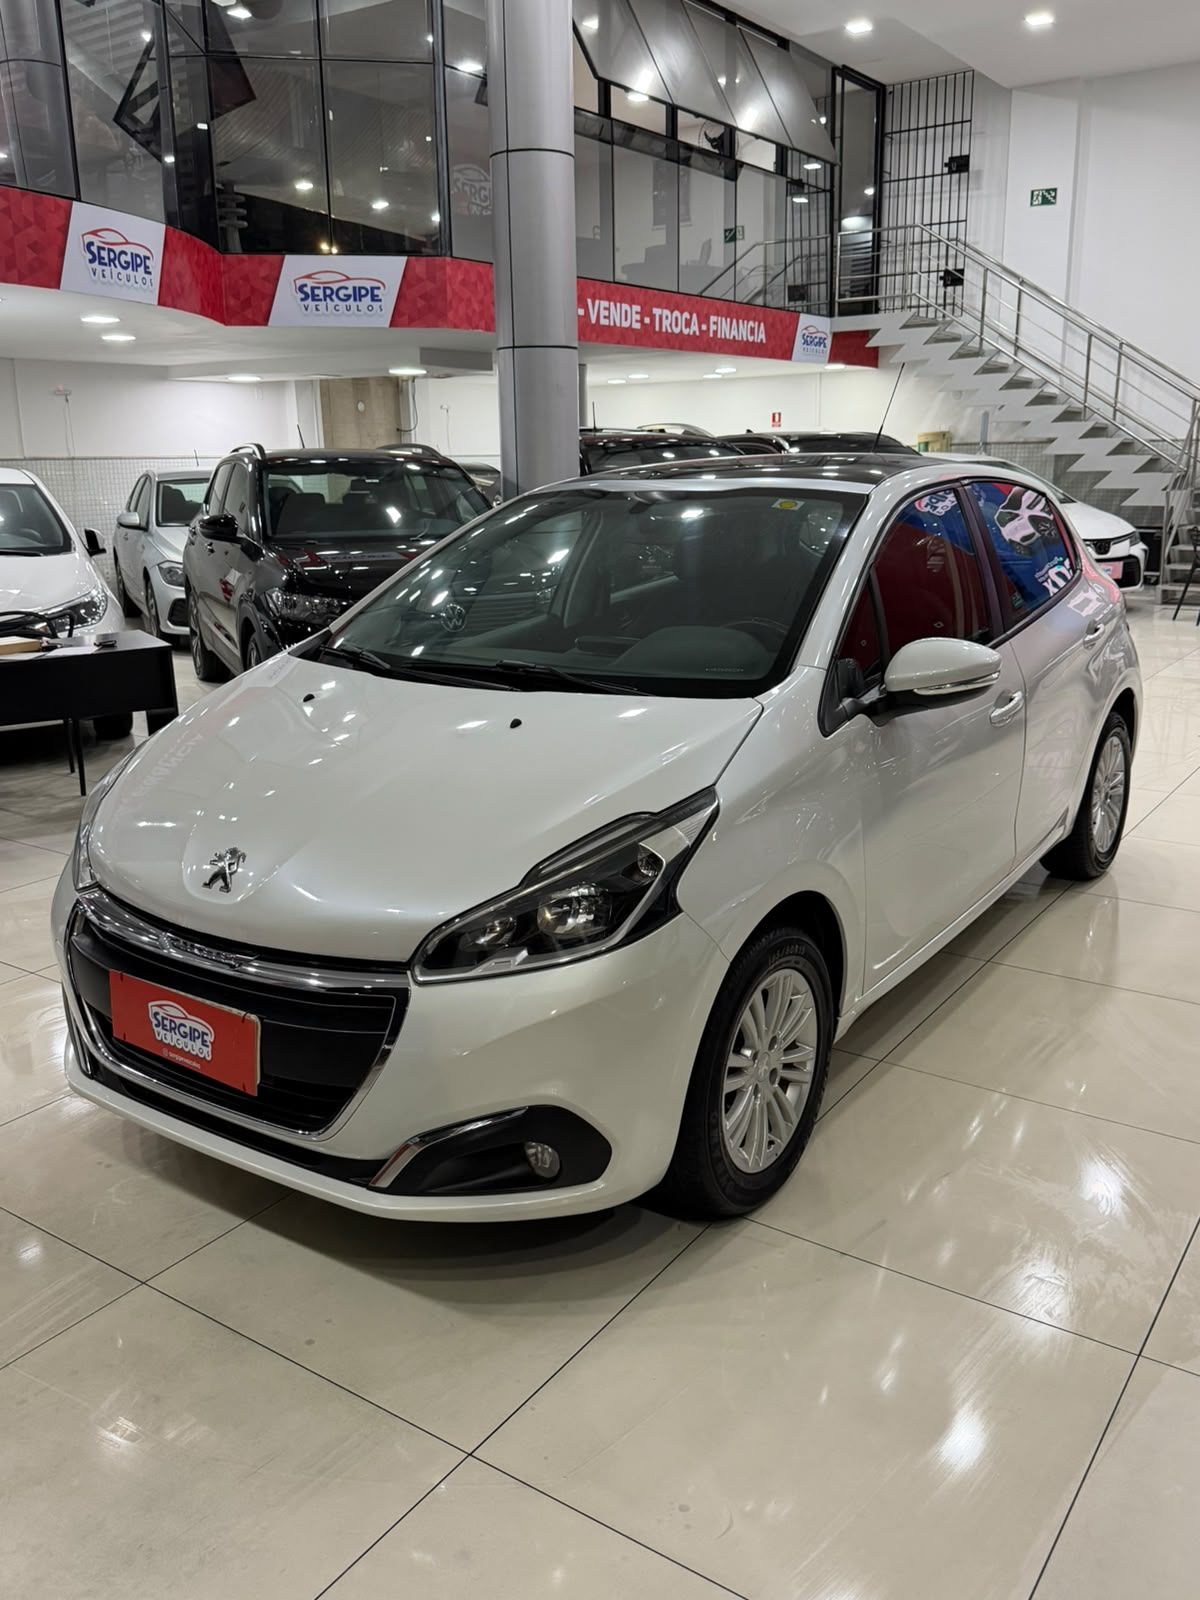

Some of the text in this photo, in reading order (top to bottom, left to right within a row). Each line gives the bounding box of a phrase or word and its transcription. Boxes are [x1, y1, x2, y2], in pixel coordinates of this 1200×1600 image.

[86, 241, 152, 275] SERGIPE
[298, 283, 382, 302] SERGIPE
[303, 302, 383, 312] VEÍCULOS
[587, 298, 641, 329] VENDE
[652, 307, 700, 336] TROCA
[709, 315, 766, 344] FINANCIA
[153, 1011, 209, 1048] SERGIPE
